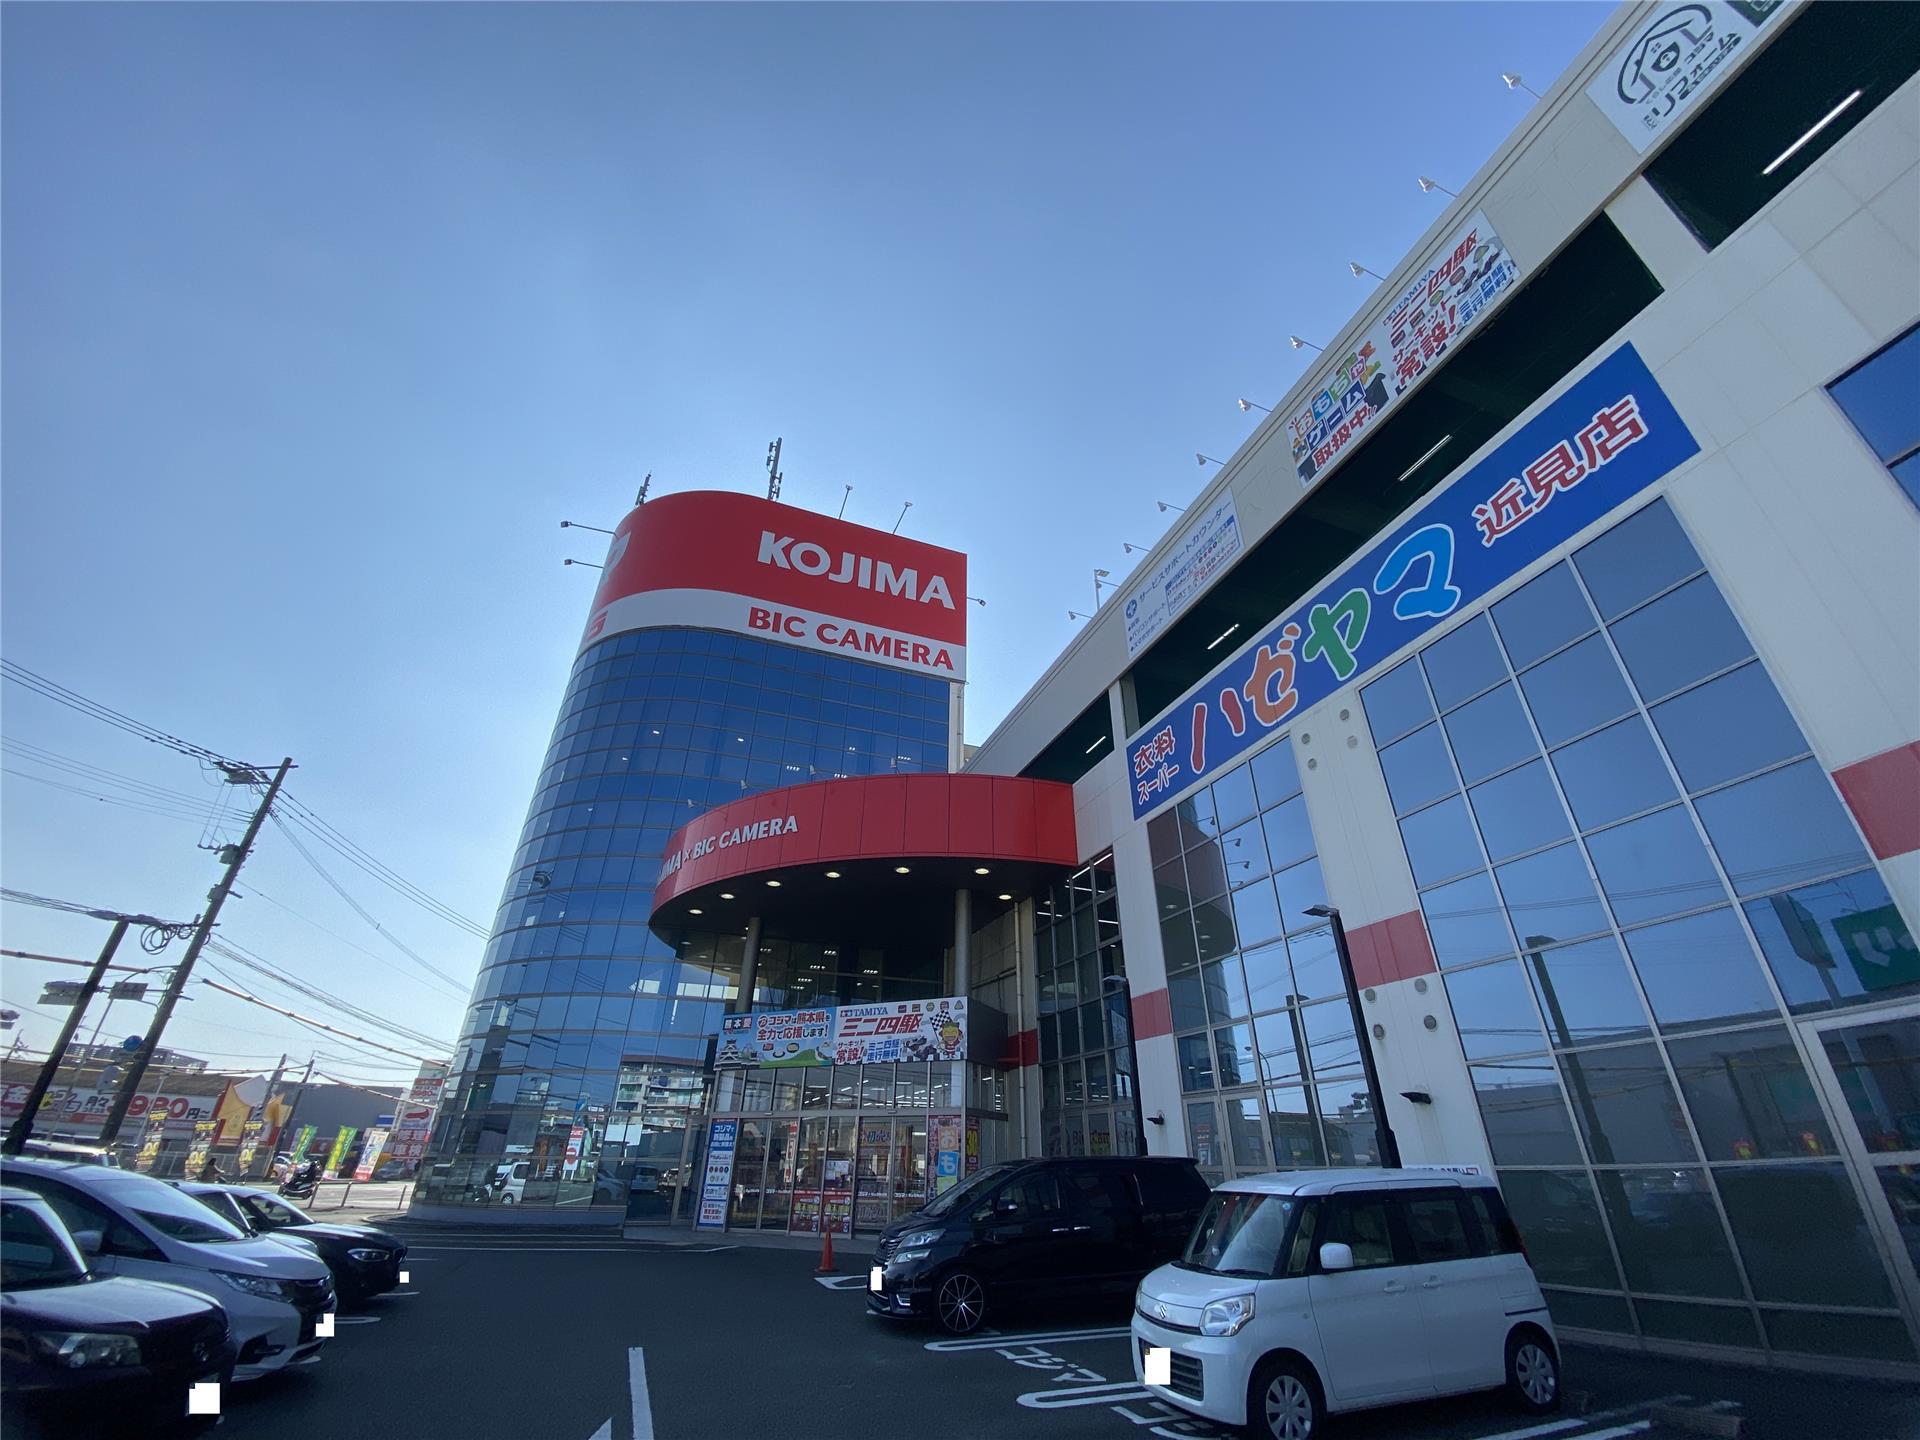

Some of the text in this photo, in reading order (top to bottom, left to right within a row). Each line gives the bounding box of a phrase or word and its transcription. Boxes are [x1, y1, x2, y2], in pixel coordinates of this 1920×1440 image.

[1652, 32, 1738, 117] リフォーム
[1390, 228, 1477, 338] ミニ四駆
[1392, 269, 1436, 317] TAMIYA
[1392, 296, 1452, 362] サーキット
[1298, 357, 1365, 433] おもちゃ
[1308, 391, 1360, 447] ゲーム
[1474, 396, 1648, 545] 近見店
[757, 530, 956, 610] KOJIMA
[1139, 502, 1231, 602] サービスサポートカウンター
[748, 606, 955, 671] BIC CAMERA
[1191, 524, 1460, 774] ハゼヤマ
[1134, 725, 1175, 778] 衣料
[1137, 763, 1179, 805] スーパー
[693, 836, 716, 860] BIC
[719, 815, 798, 849] CAMERA
[757, 1025, 828, 1040] 全力で応援します!
[839, 1014, 924, 1037] ミニ四駆
[853, 1007, 888, 1016] TAMIYA
[838, 1039, 864, 1048] サーキット
[868, 1039, 899, 1050] ミニ四駆
[995, 1347, 1107, 1382] コジマ
